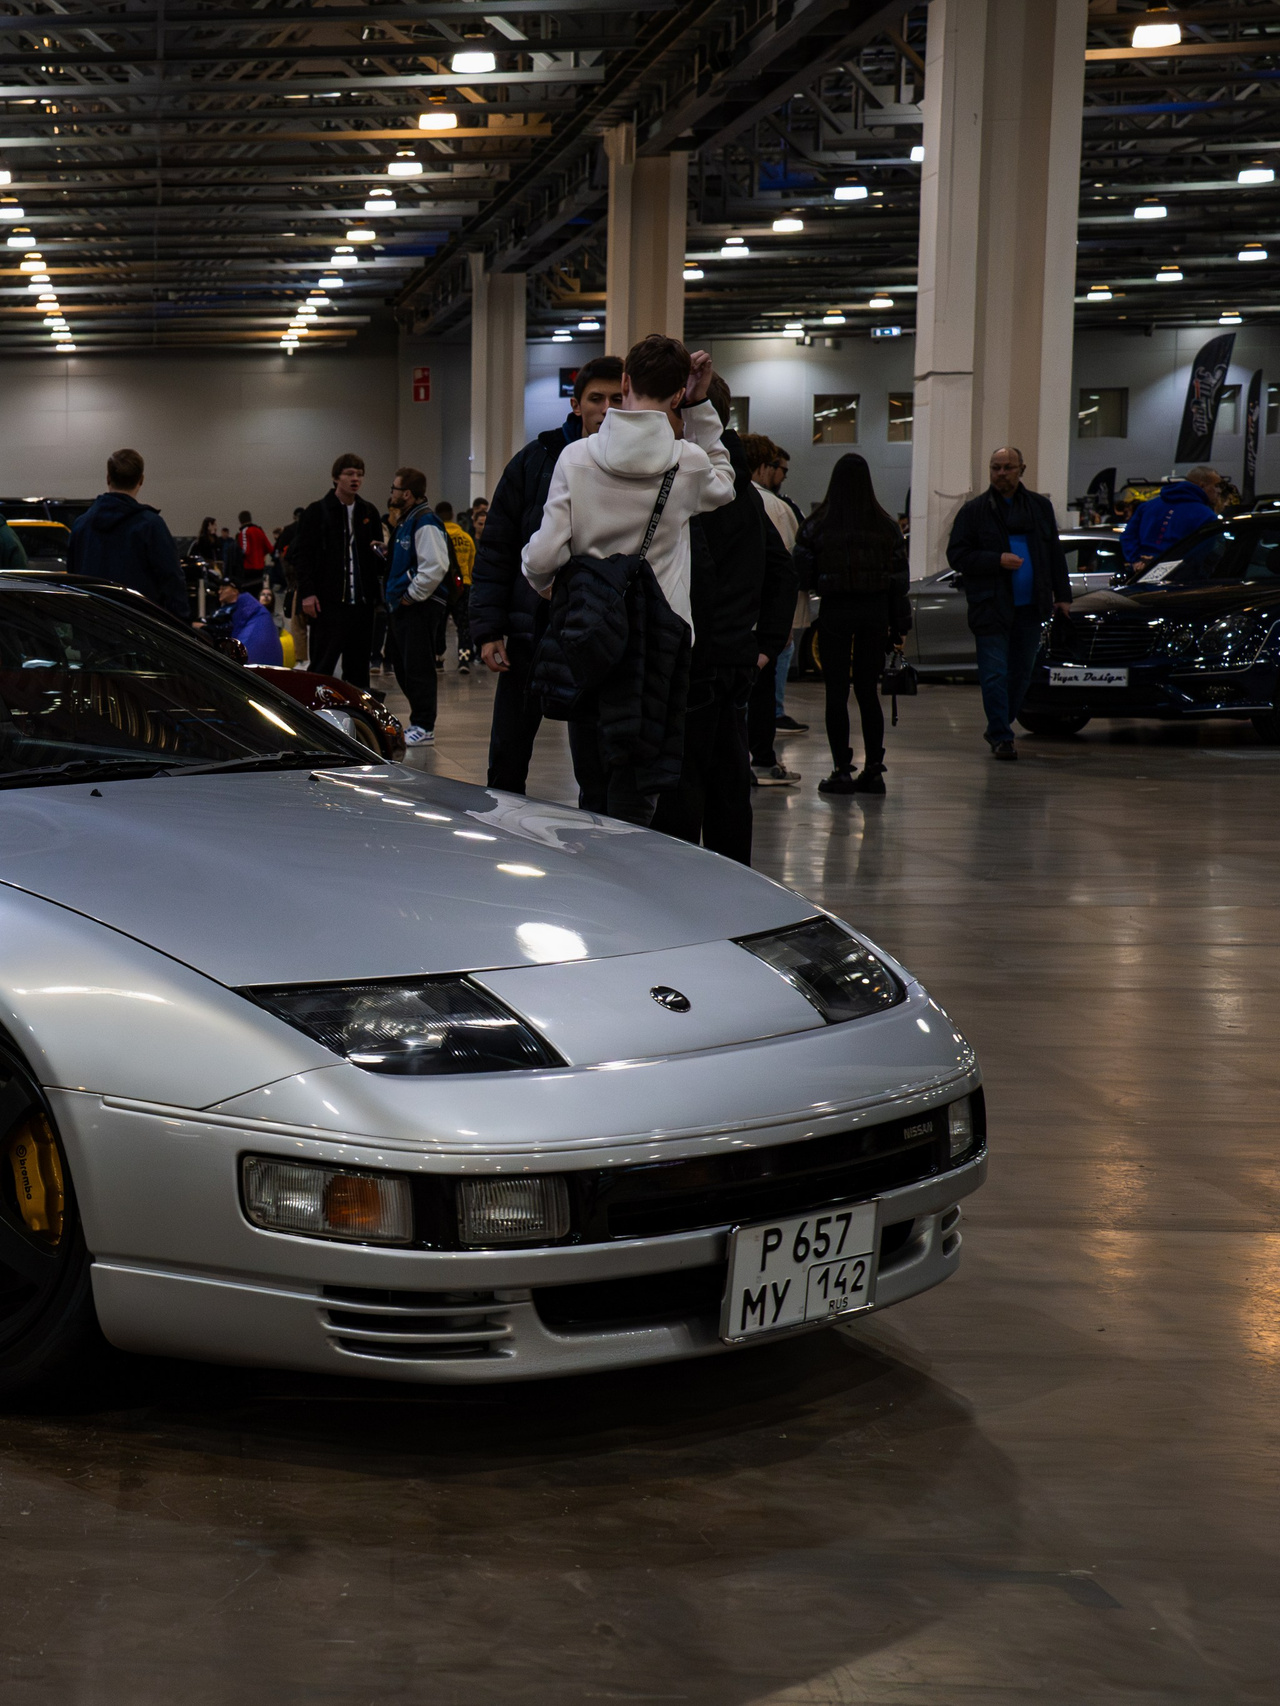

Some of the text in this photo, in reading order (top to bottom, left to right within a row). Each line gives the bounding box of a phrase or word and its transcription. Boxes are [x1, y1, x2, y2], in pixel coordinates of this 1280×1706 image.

[657, 464, 678, 506] REME
[1083, 672, 1123, 683] Design
[903, 1121, 933, 1140] NISSAN
[20, 1159, 32, 1199] brembo
[761, 1212, 853, 1272] P 657
[741, 1260, 866, 1331] MY 142
[829, 1296, 849, 1312] RUS
